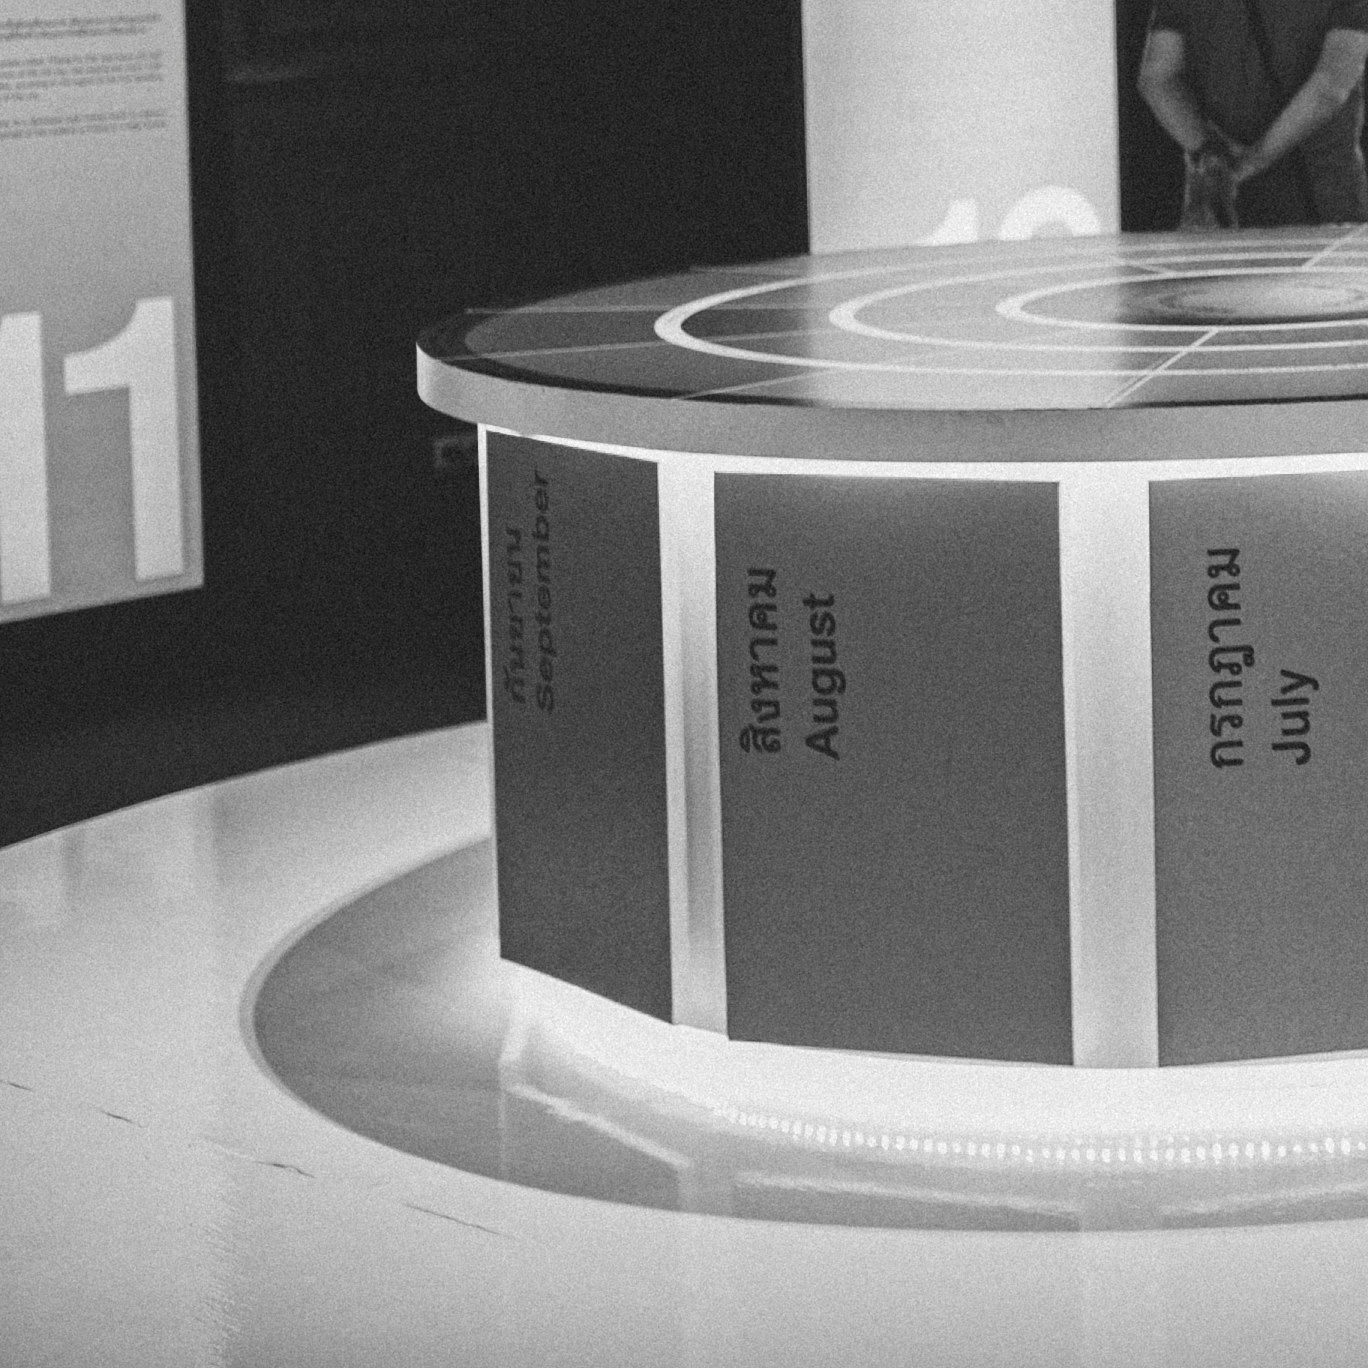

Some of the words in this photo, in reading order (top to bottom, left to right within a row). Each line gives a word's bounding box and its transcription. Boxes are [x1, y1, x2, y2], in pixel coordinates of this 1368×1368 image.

[503, 526, 526, 705] กันยายน
[531, 468, 557, 713] September
[739, 567, 782, 754] สิงหาคม
[802, 592, 847, 761] August
[1206, 547, 1255, 769] กรกฎาคม
[1270, 668, 1320, 766] July
